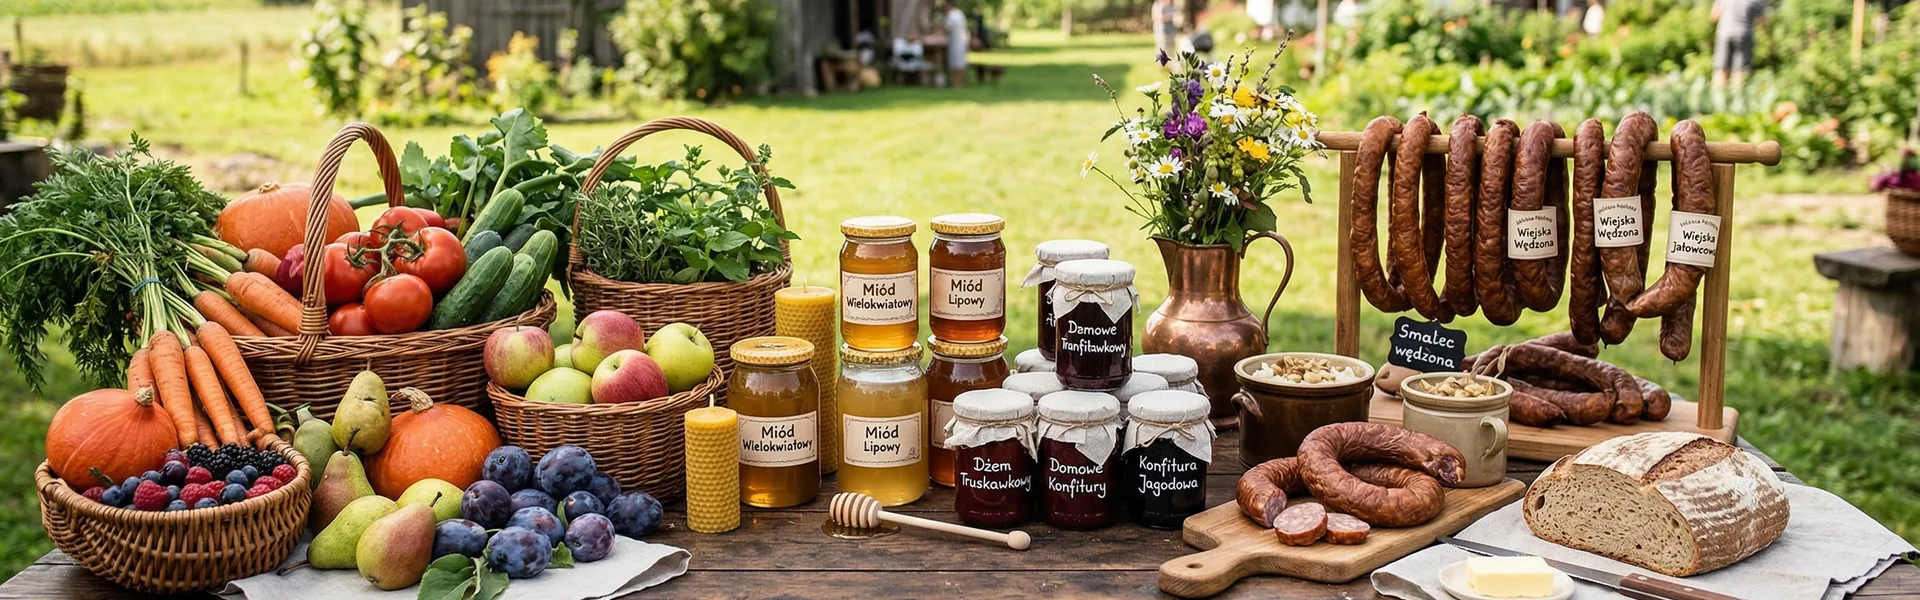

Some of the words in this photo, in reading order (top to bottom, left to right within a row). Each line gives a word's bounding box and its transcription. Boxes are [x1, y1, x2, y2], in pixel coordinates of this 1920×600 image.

[1600, 215, 1636, 229] Wiejska
[1517, 227, 1552, 240] Wiejska
[1597, 228, 1639, 241] Wędzona
[1682, 230, 1716, 245] Wiejska
[1514, 240, 1554, 252] Wędzona
[863, 283, 896, 297] Miód
[951, 279, 983, 292] Miód
[846, 297, 913, 310] Wielokwiatowy
[948, 294, 986, 308] Lipowy
[1395, 345, 1455, 369] wędzona
[761, 424, 795, 439] Miód
[865, 425, 899, 440] Miód
[742, 439, 813, 452] Wielokwiatowy
[864, 441, 901, 456] Lipowy
[973, 456, 1012, 473] Dżem
[1049, 457, 1104, 475] Domowe
[1139, 455, 1198, 478] Konfitura
[960, 472, 1031, 492] Truskawkowy
[1048, 476, 1107, 499] Konfitury
[1138, 474, 1199, 497] Jagodowa
